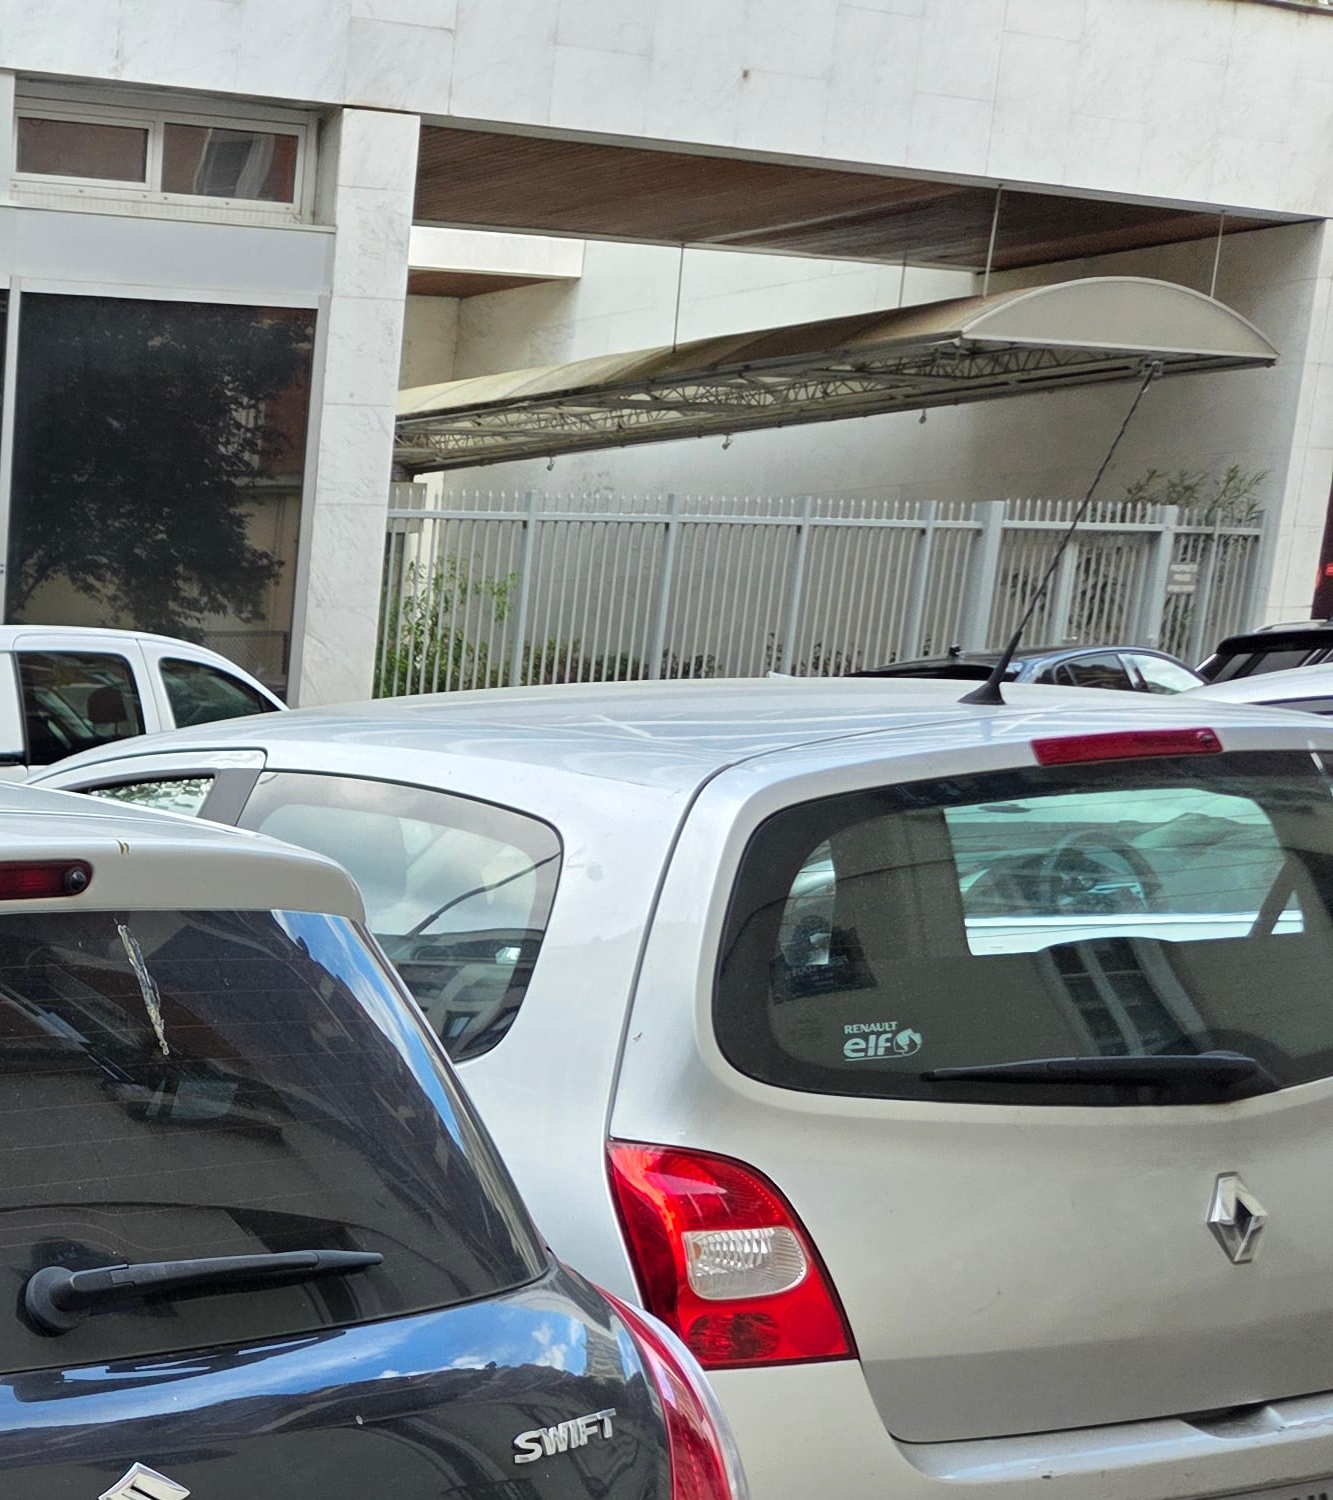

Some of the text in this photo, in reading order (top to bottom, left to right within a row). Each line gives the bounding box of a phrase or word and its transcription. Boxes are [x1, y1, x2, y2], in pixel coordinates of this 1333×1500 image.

[844, 1021, 898, 1034] RENAULT
[843, 1033, 892, 1058] elf
[514, 1407, 617, 1464] SWIFT
